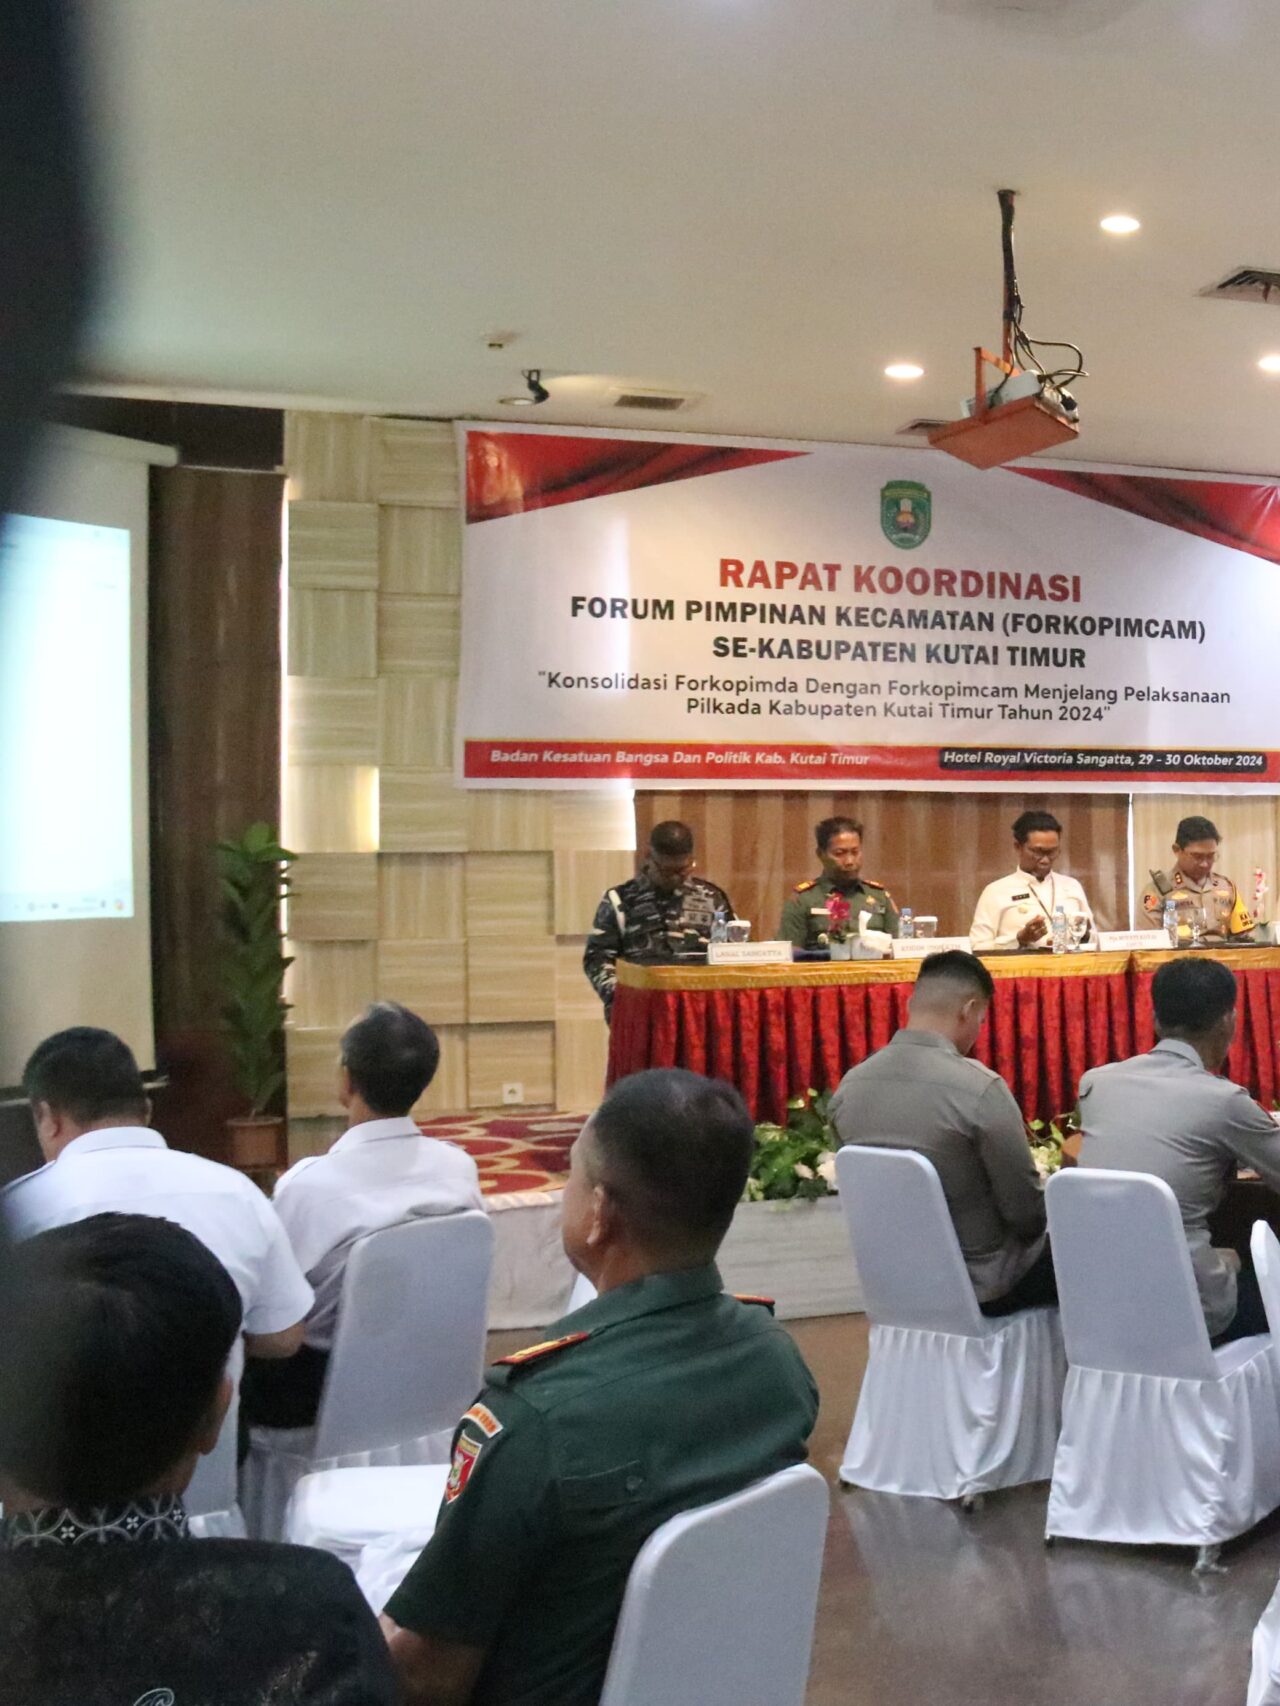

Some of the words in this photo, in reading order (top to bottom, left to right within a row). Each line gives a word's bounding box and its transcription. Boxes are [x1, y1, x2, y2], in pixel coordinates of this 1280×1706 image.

[719, 558, 842, 592] RAPAT
[853, 564, 1081, 603] KOORDINASI
[570, 596, 675, 621] FORUM
[685, 600, 826, 626] PIMPINAN
[836, 606, 995, 632] KECAMATAN
[1002, 612, 1206, 644] (FORKOPIMCAM)
[712, 636, 916, 664] SE-KABUPATEN
[926, 643, 999, 666] KUTAI
[1006, 646, 1086, 668] TIMUR
[538, 671, 668, 692] "Konsolidasi
[675, 675, 798, 699] Forkopimda
[805, 677, 881, 701] Dengan
[888, 680, 1018, 704] Forkopimcam
[1024, 682, 1118, 706] Menjelang
[1124, 685, 1231, 704] Pelaksanaan
[686, 697, 762, 716] Pilkada
[768, 699, 877, 722] Kabupaten
[883, 702, 933, 719] Kutai
[939, 704, 993, 720] Timur
[997, 704, 1053, 721] Tahun
[1058, 705, 1111, 722] 2024"
[490, 750, 539, 764] Badan
[542, 750, 612, 764] Kesatuan
[615, 751, 669, 767] Bangsa
[673, 751, 702, 765] Dan
[705, 751, 752, 765] Politik
[755, 752, 786, 766] Kab.
[789, 752, 827, 766] Kutai
[830, 753, 870, 766] Timur
[943, 751, 982, 764] Hotel
[984, 752, 1021, 768] Royal
[1023, 752, 1073, 766] Victoria
[1076, 753, 1135, 769] Sangatta,
[1138, 754, 1153, 766] 29
[1165, 754, 1181, 766] 30
[1183, 754, 1233, 767] Oktober
[1235, 755, 1263, 767] 2024
